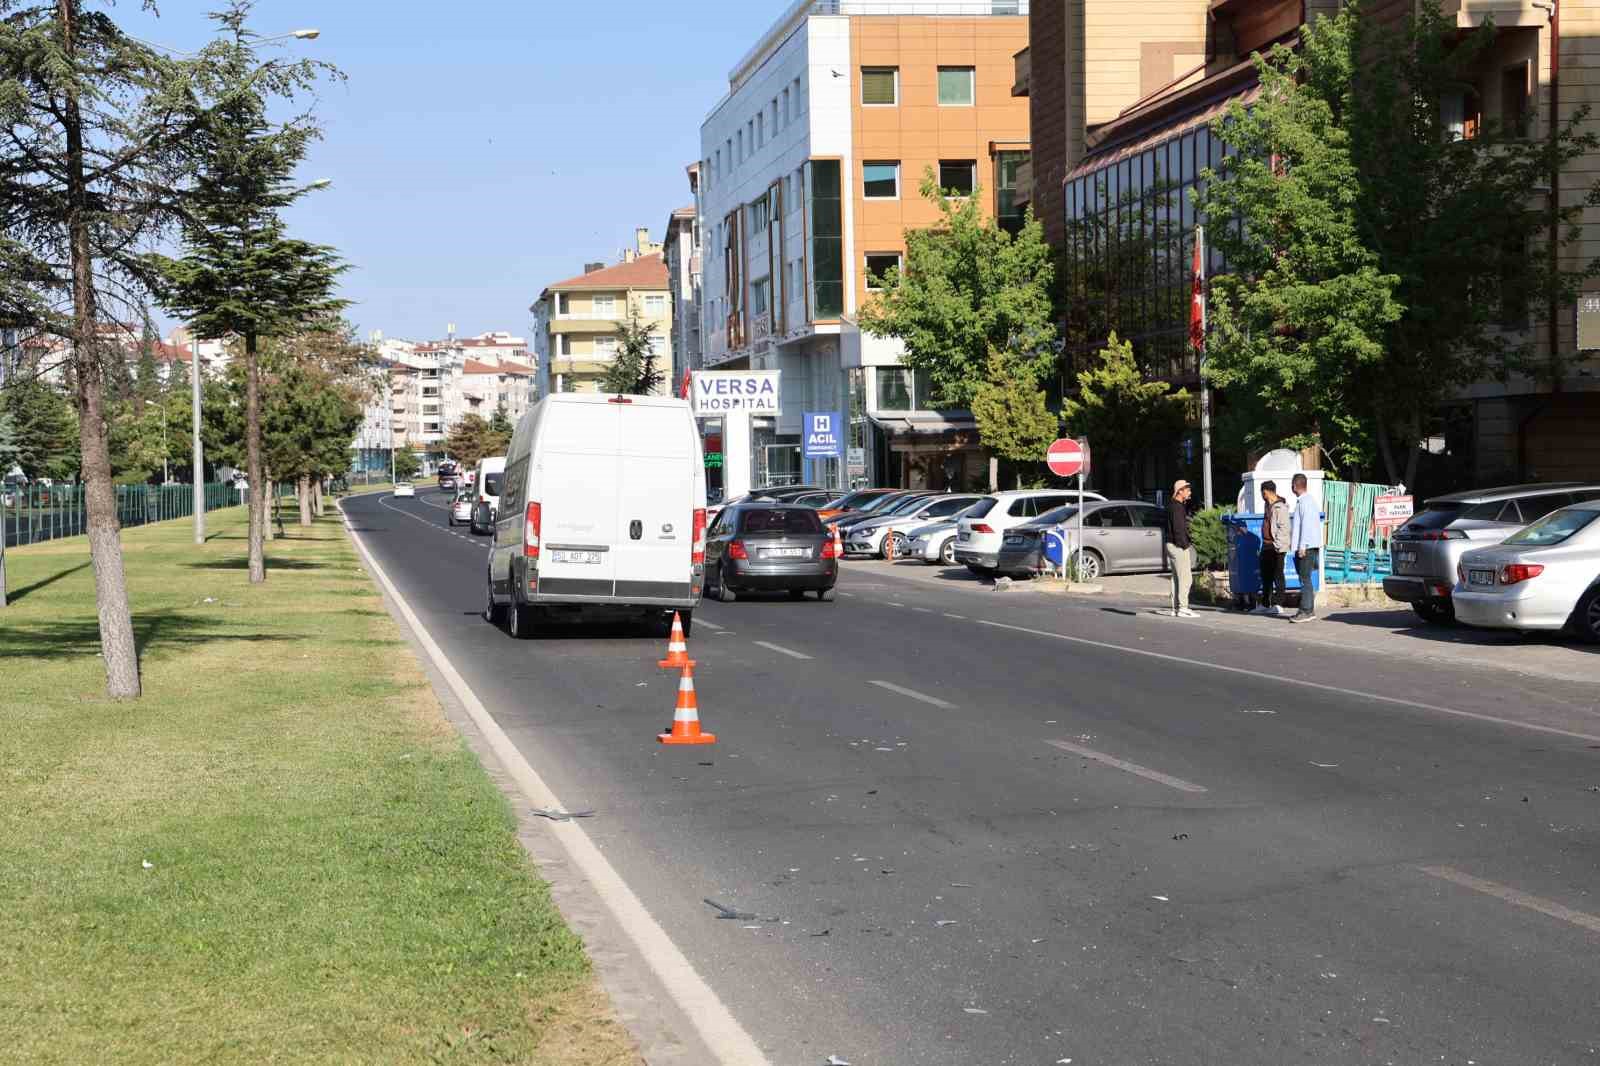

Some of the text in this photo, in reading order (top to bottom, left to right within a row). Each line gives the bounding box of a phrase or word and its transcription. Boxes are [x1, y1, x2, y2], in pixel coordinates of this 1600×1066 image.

[700, 378, 774, 395] VERSA
[700, 398, 775, 410] HOSPITAL
[816, 418, 828, 430] H
